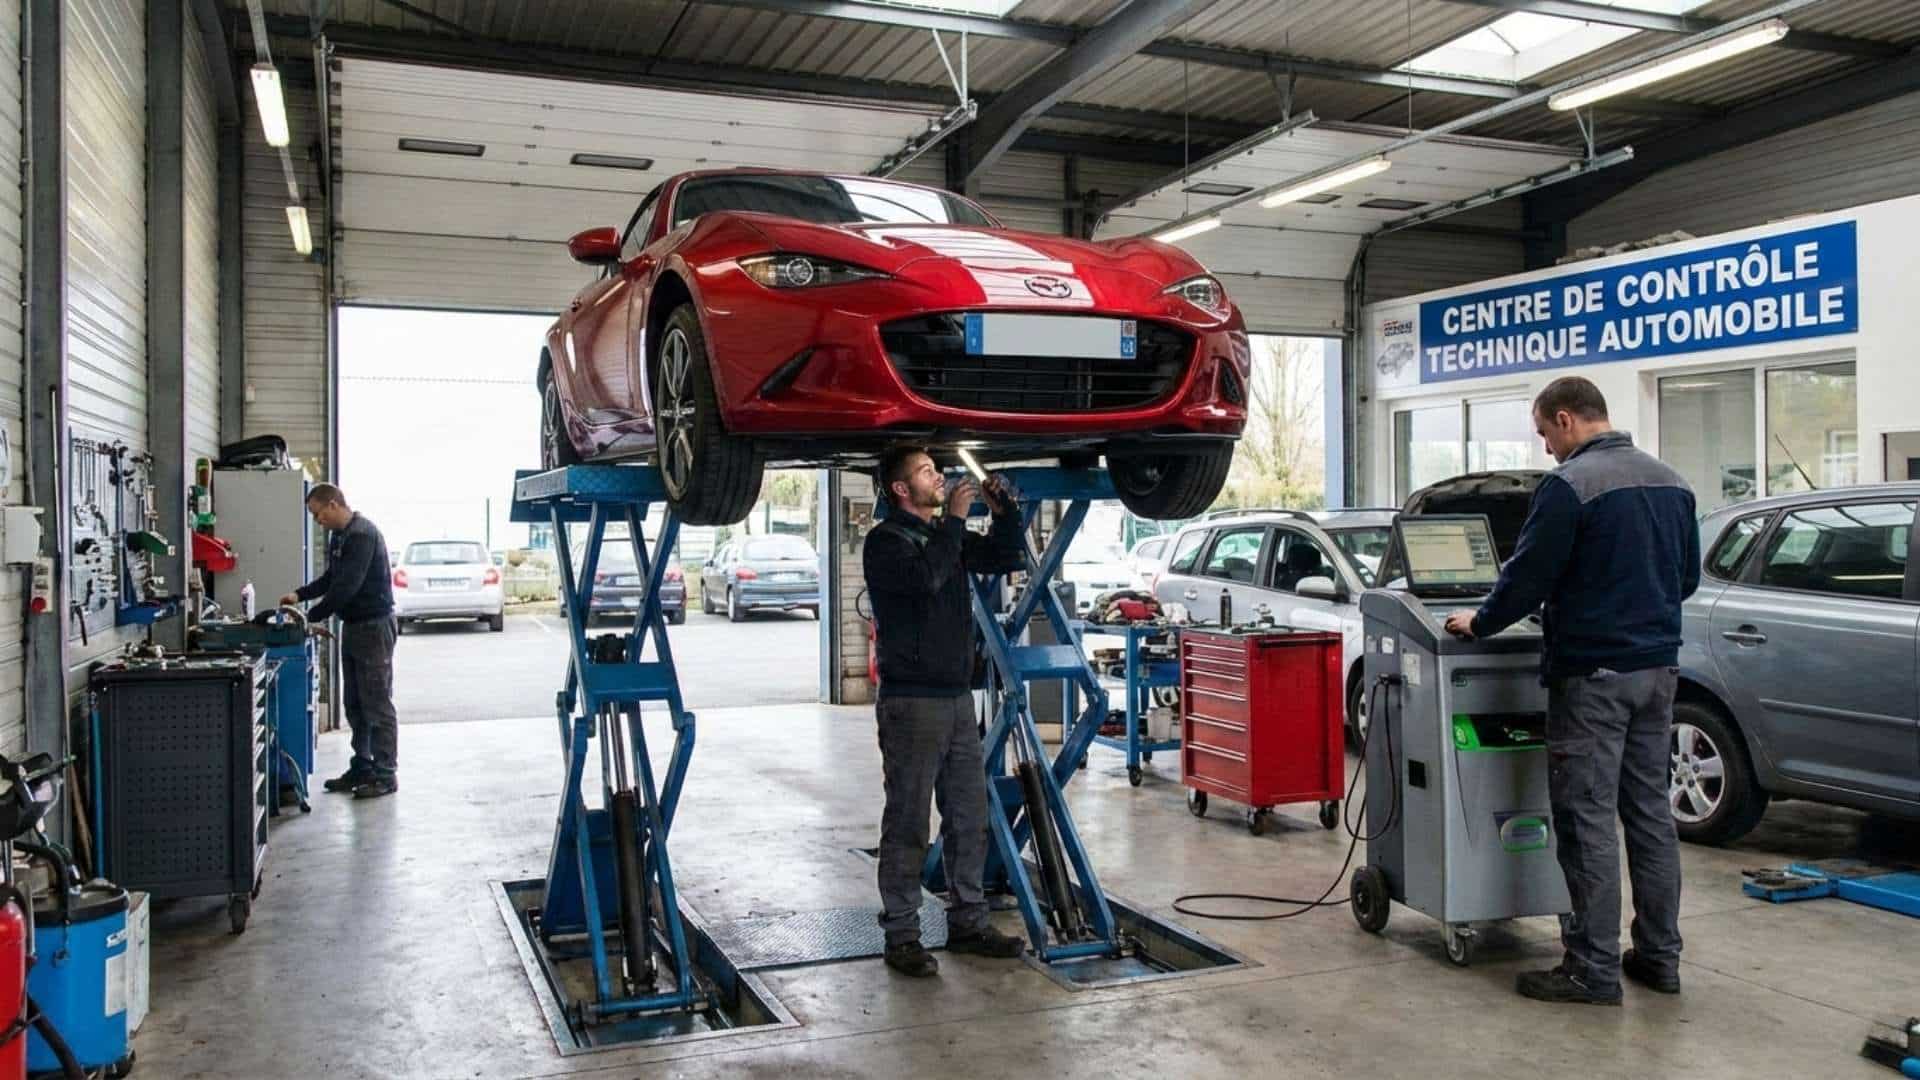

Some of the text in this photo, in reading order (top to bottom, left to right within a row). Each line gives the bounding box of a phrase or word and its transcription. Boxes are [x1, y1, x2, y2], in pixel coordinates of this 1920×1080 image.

[1426, 285, 1844, 374] TECHNIQUE AUTOMOBILE
[1442, 241, 1819, 336] CENTRE DE CONTRÔLE
